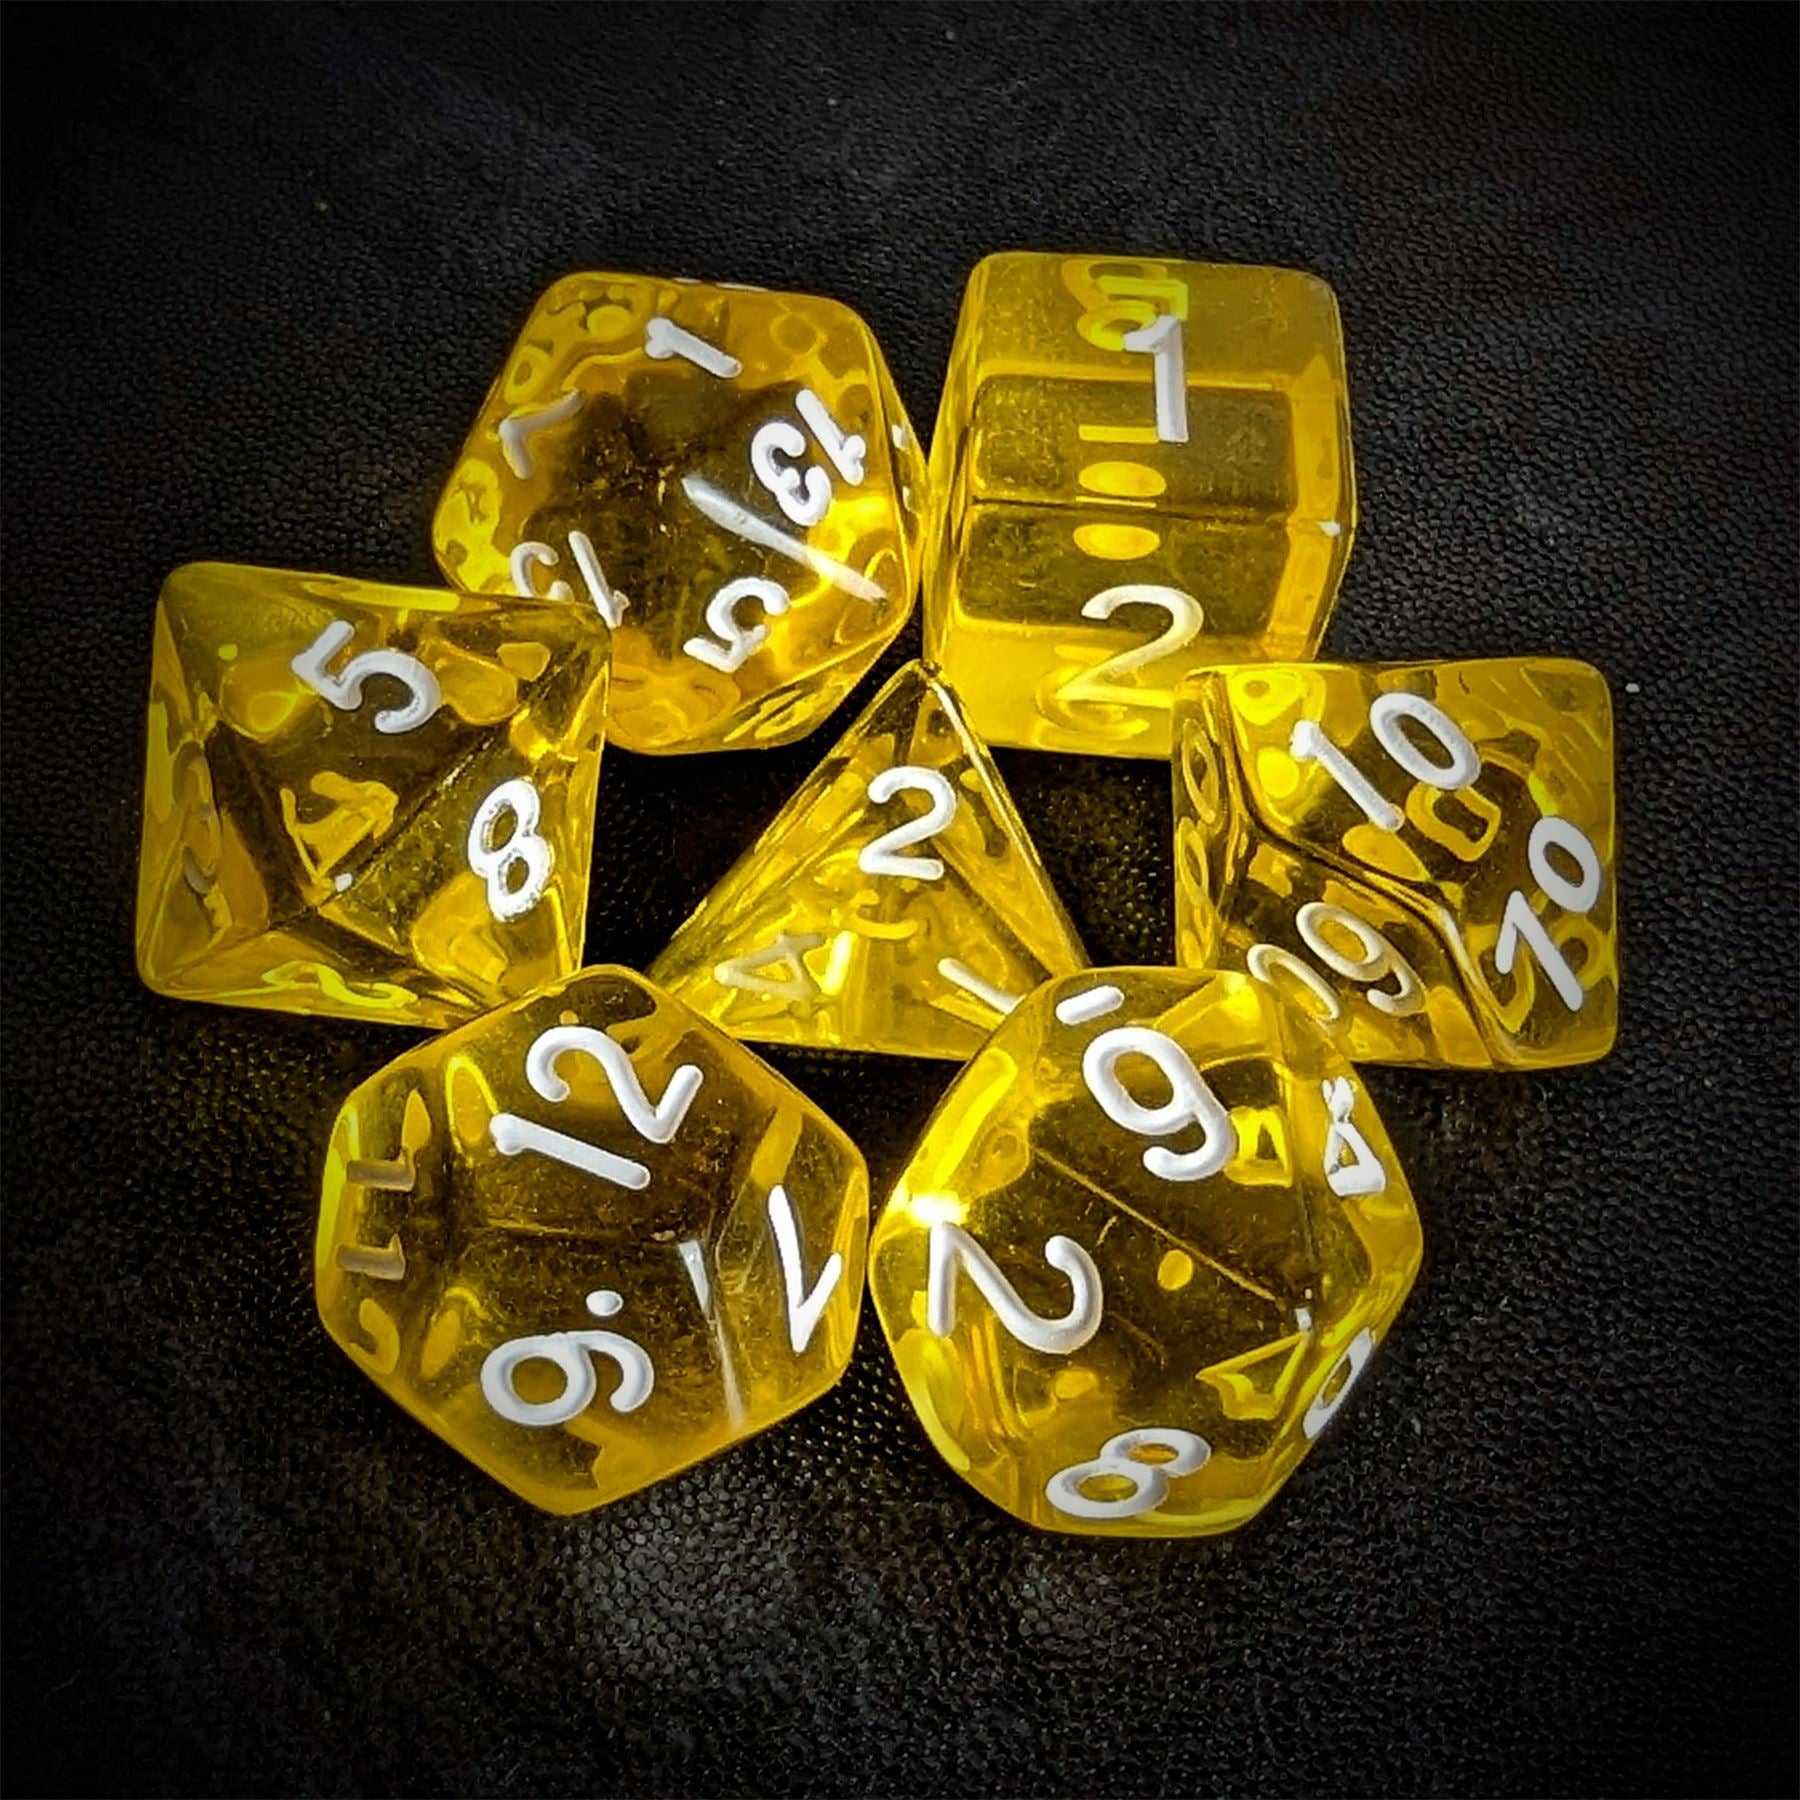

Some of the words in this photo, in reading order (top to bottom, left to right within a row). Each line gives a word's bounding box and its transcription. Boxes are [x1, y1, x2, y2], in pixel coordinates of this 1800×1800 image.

[646, 317, 742, 378] 1
[1122, 315, 1190, 443] 1
[751, 389, 866, 526] 13
[291, 620, 441, 734] 5
[683, 577, 789, 673] 5
[1055, 584, 1204, 708] 2
[858, 766, 956, 880] 2
[1290, 693, 1481, 832] 10
[468, 779, 553, 922] 8
[1495, 816, 1600, 1012] 70
[490, 1026, 703, 1190] 12
[927, 1221, 1103, 1354] 2
[1046, 1428, 1211, 1519] 8
